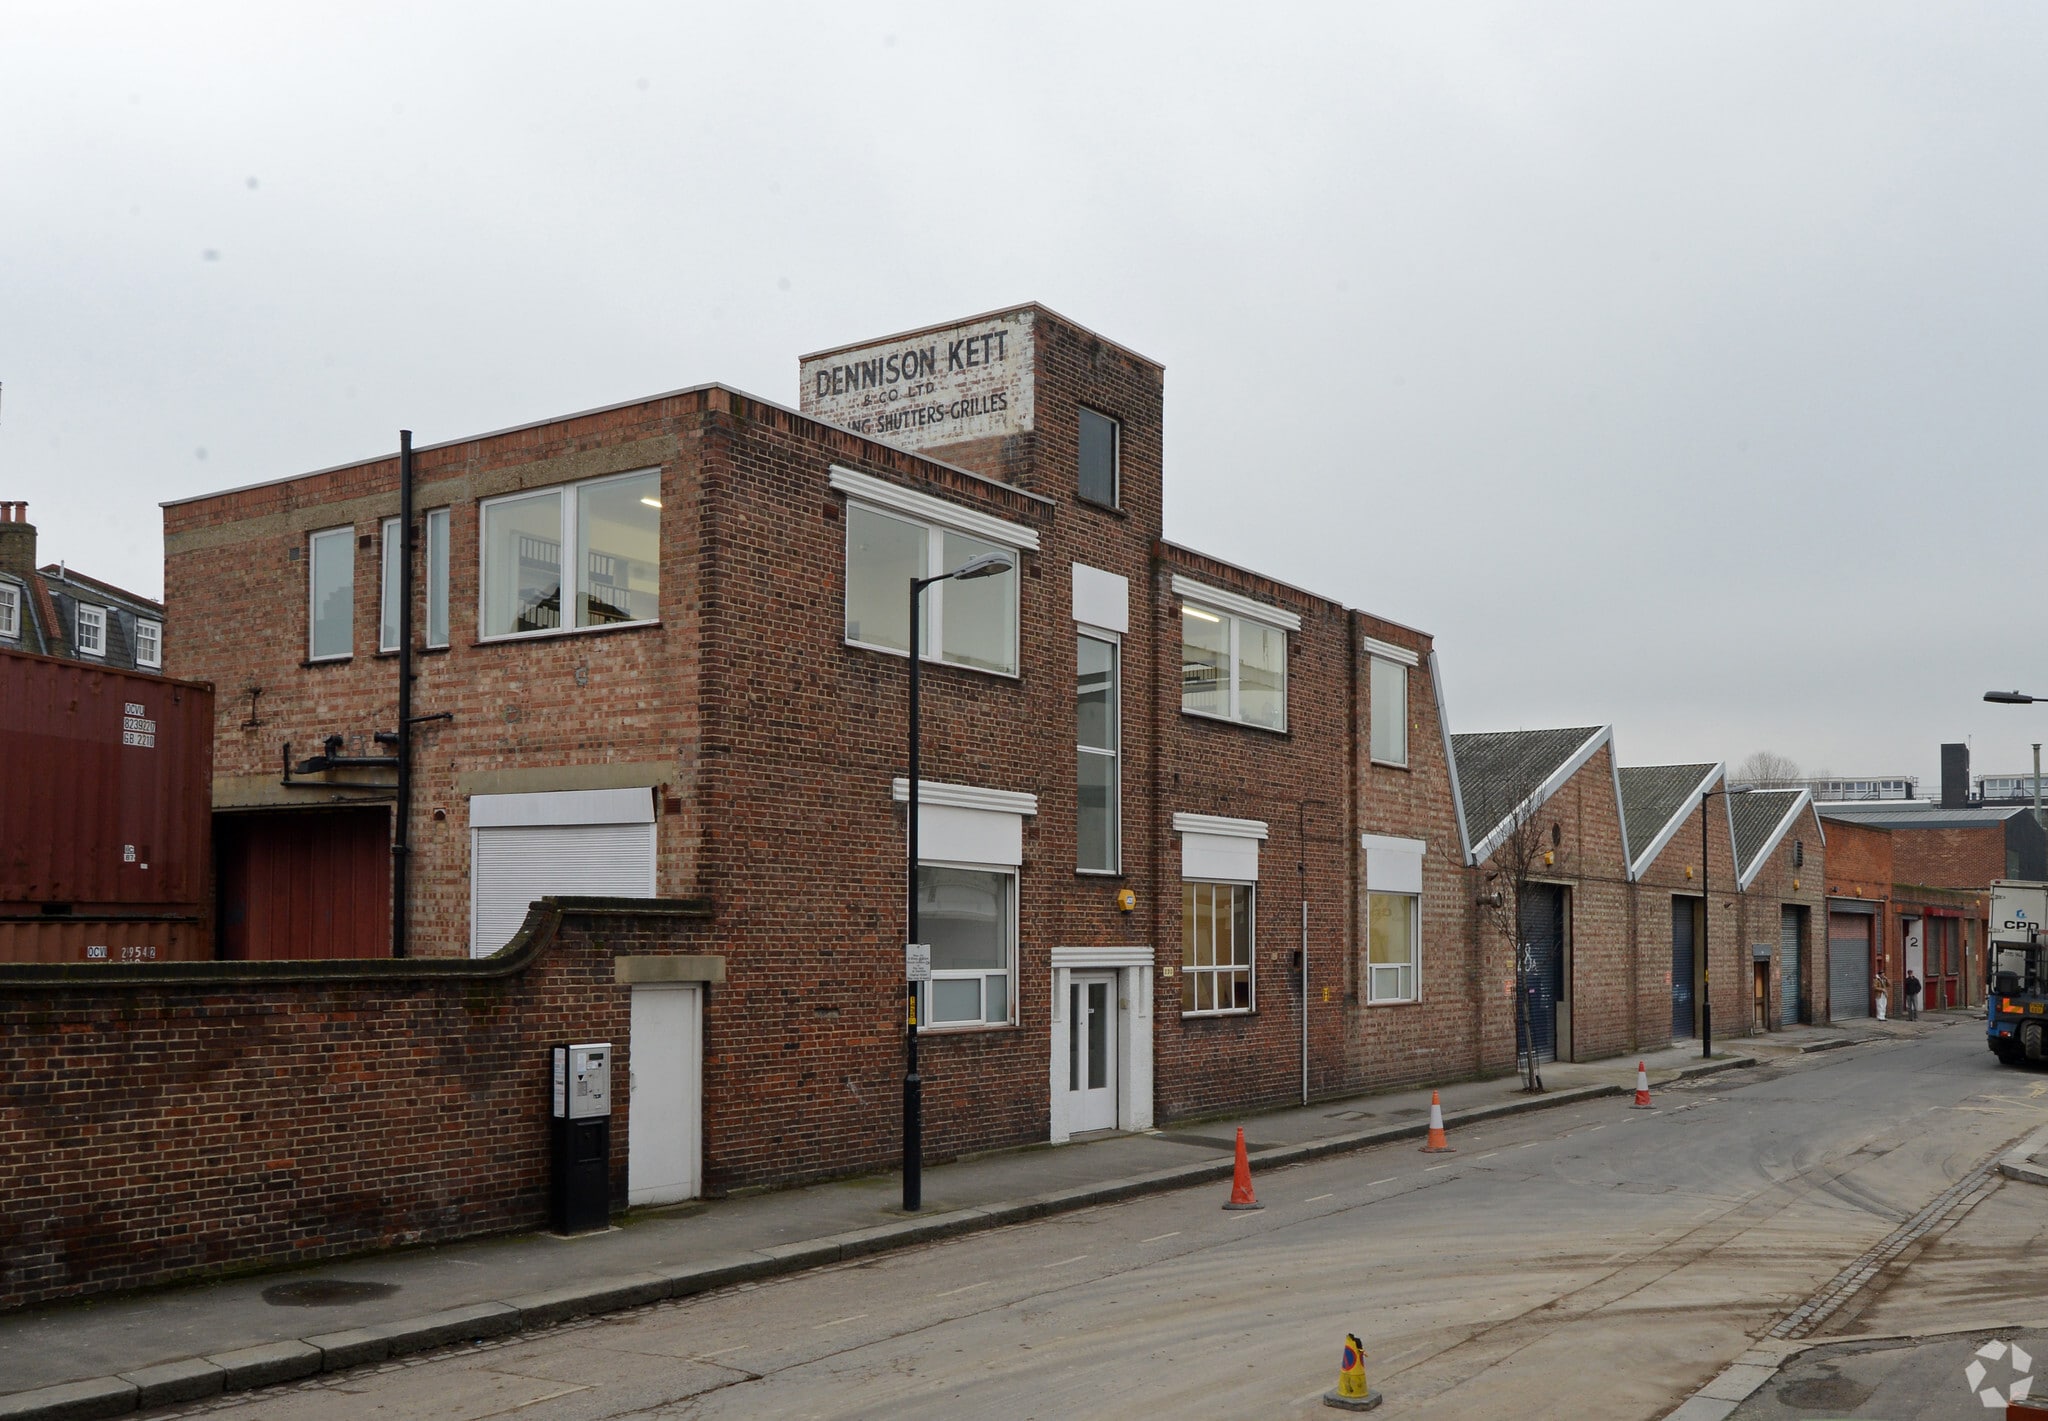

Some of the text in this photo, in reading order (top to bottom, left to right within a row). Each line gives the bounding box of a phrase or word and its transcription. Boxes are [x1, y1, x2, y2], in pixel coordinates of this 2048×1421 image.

[816, 330, 1008, 399] DENNISON KETT
[862, 394, 873, 407] &
[125, 703, 145, 716] OCVU
[1910, 937, 1920, 947] 2
